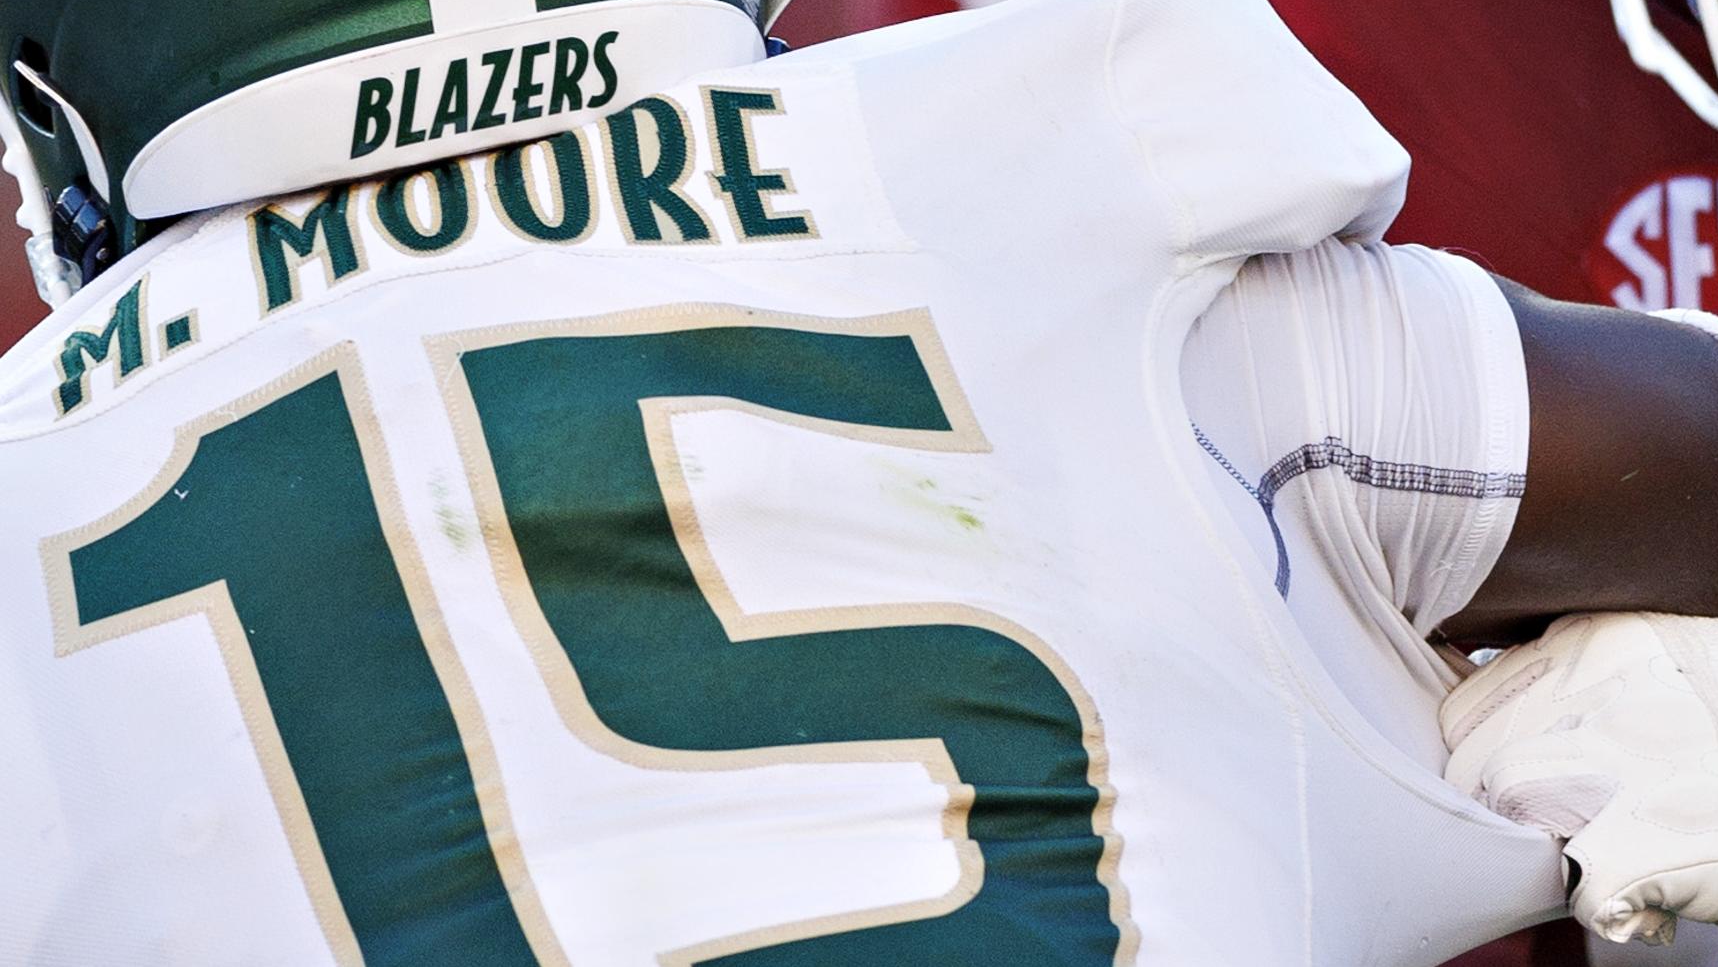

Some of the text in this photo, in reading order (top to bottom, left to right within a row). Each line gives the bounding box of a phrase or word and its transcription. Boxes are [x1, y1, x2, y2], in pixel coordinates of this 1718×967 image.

[55, 84, 821, 421] M. MOORE
[350, 31, 620, 160] BLAZERS
[38, 301, 1141, 967] 15
